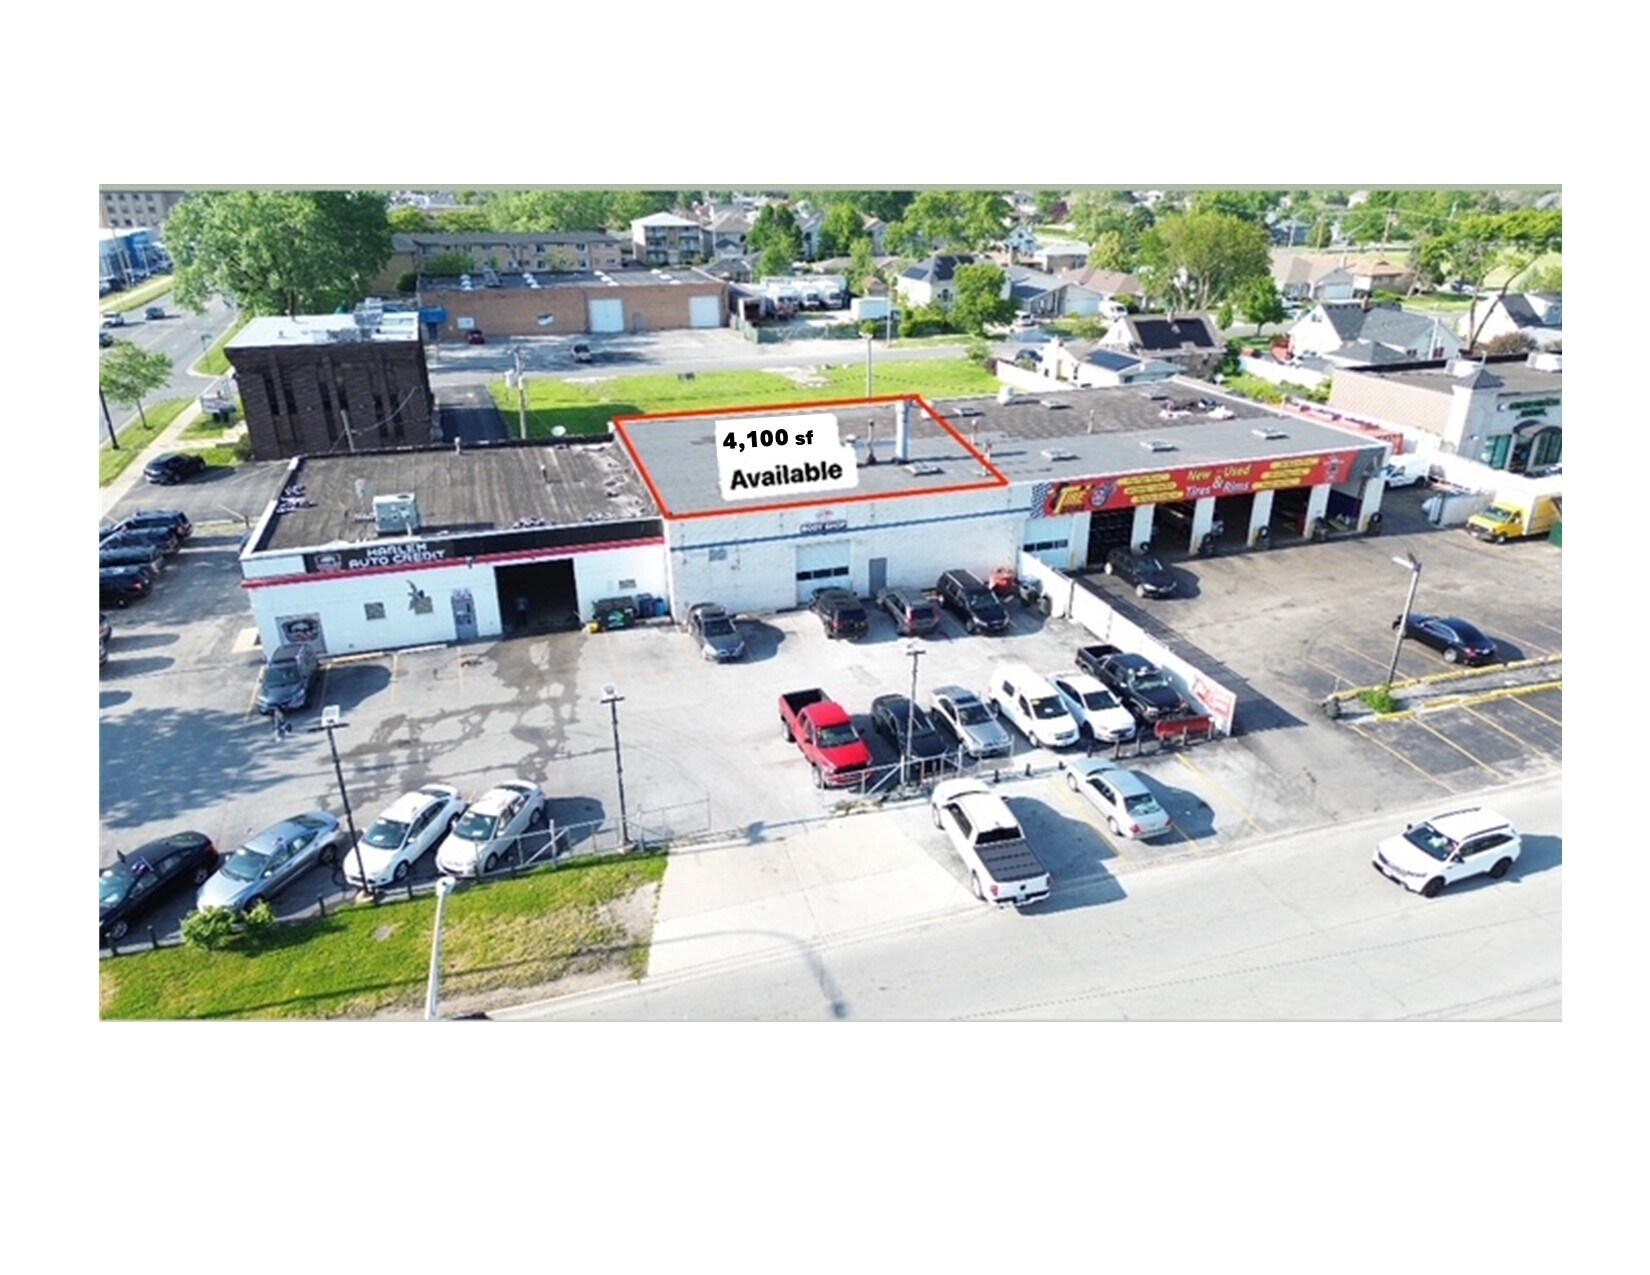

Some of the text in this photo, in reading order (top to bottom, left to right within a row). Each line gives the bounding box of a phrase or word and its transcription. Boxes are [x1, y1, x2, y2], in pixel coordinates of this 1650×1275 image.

[1186, 470, 1212, 481] New
[1224, 464, 1252, 478] Used
[1186, 486, 1212, 498] Tires
[1223, 481, 1250, 493] Rims
[1212, 475, 1225, 489] &
[366, 542, 428, 557] HARLEM
[349, 556, 389, 569] AUTO
[393, 550, 446, 563] CREDIT
